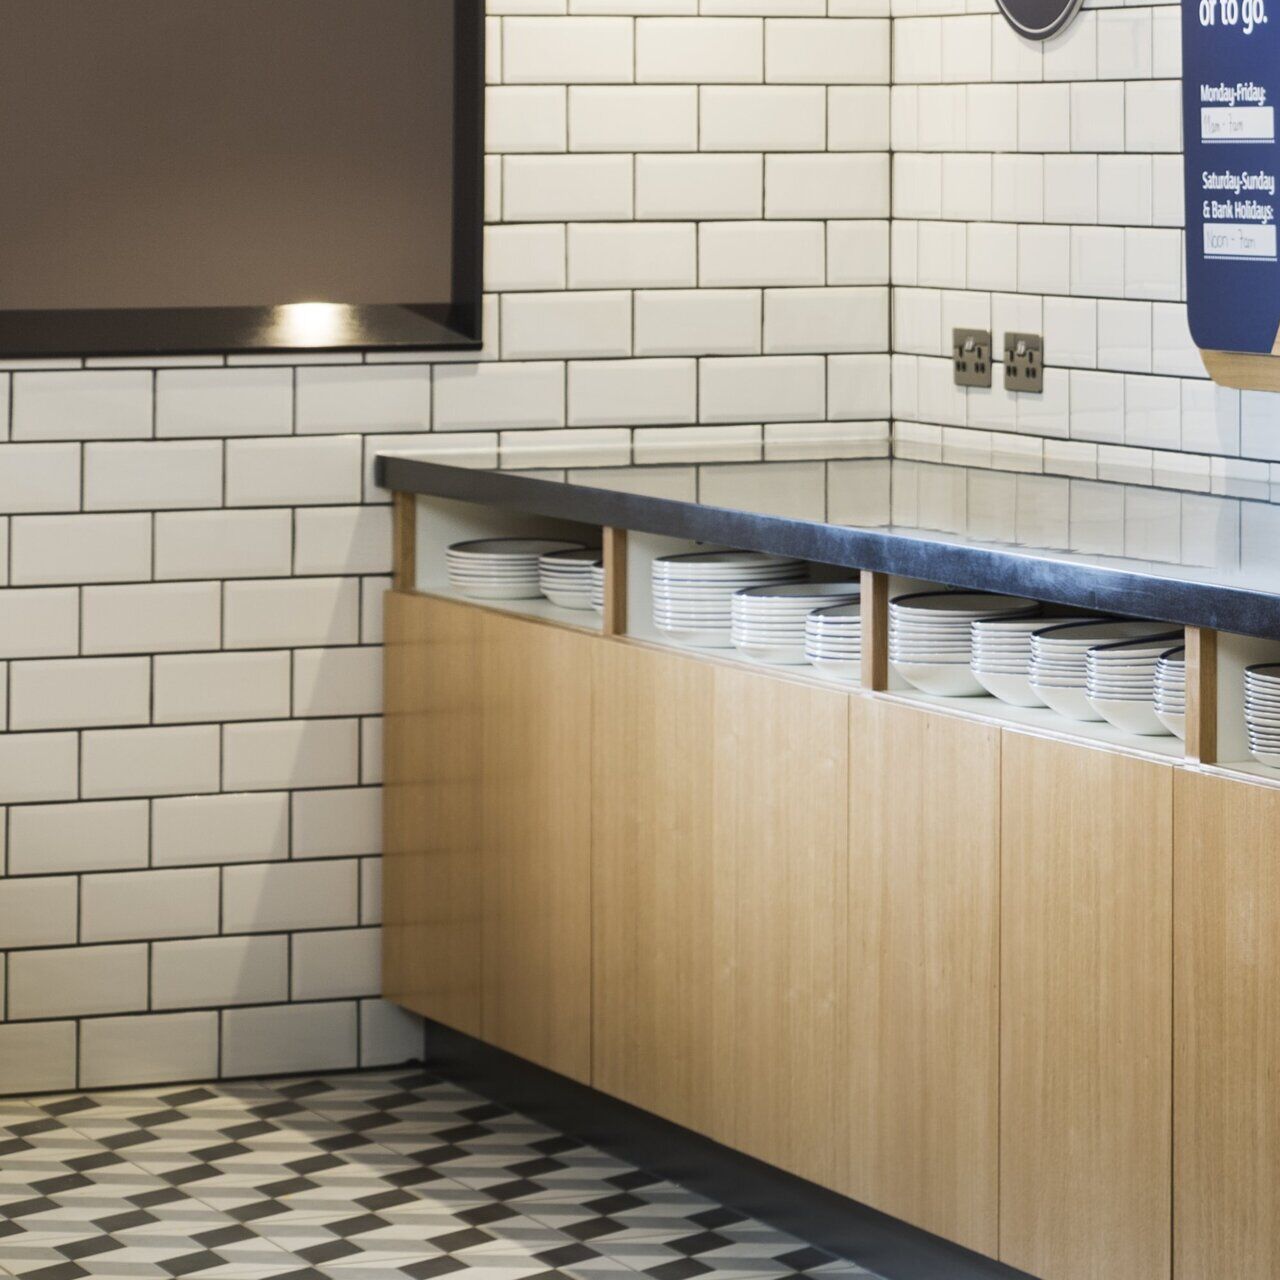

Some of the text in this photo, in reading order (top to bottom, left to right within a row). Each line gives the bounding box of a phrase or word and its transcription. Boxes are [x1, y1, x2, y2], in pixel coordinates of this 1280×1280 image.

[1200, 82, 1266, 107] Monday-Friday:
[1202, 171, 1275, 195] Saturday-Sunday
[1203, 200, 1274, 224] & Bank Holidays:
